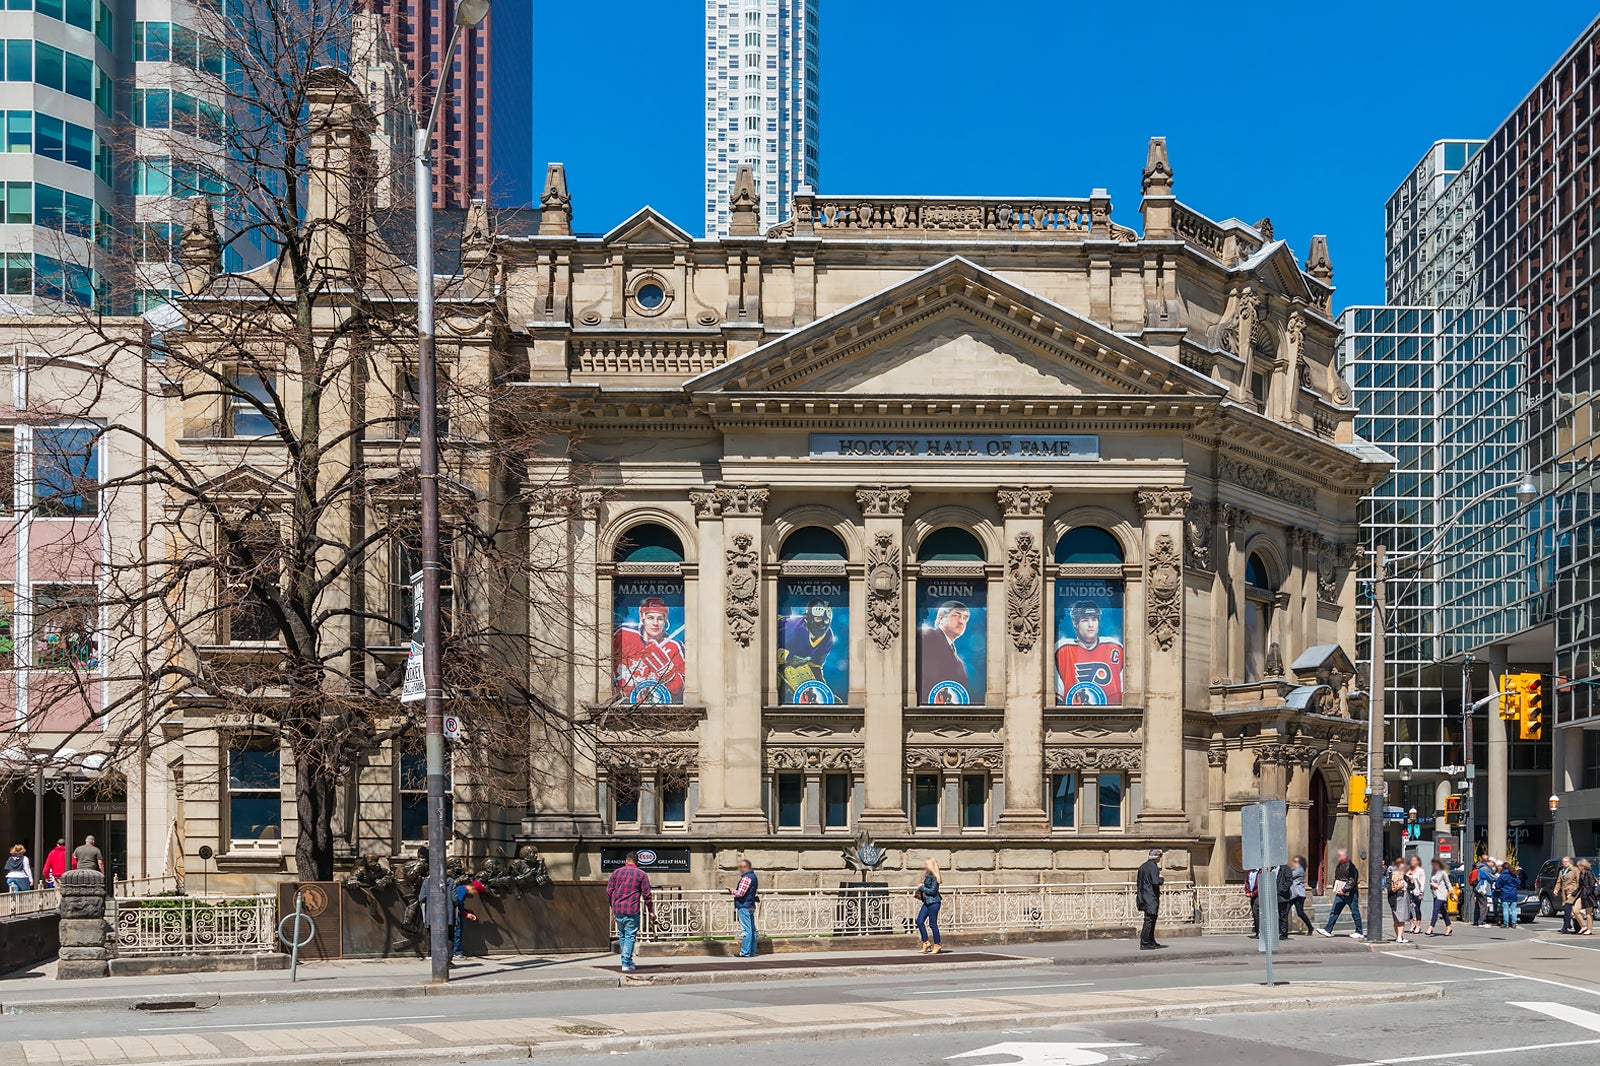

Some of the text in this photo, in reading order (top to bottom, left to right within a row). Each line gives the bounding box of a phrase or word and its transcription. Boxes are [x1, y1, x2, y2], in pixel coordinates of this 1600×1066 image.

[838, 440, 1071, 456] HOCKEY HALL OF FAME
[618, 584, 683, 595] MAKAROV
[787, 585, 841, 596] VACHON
[927, 585, 973, 598] QUINN
[1059, 586, 1114, 597] LINDROS
